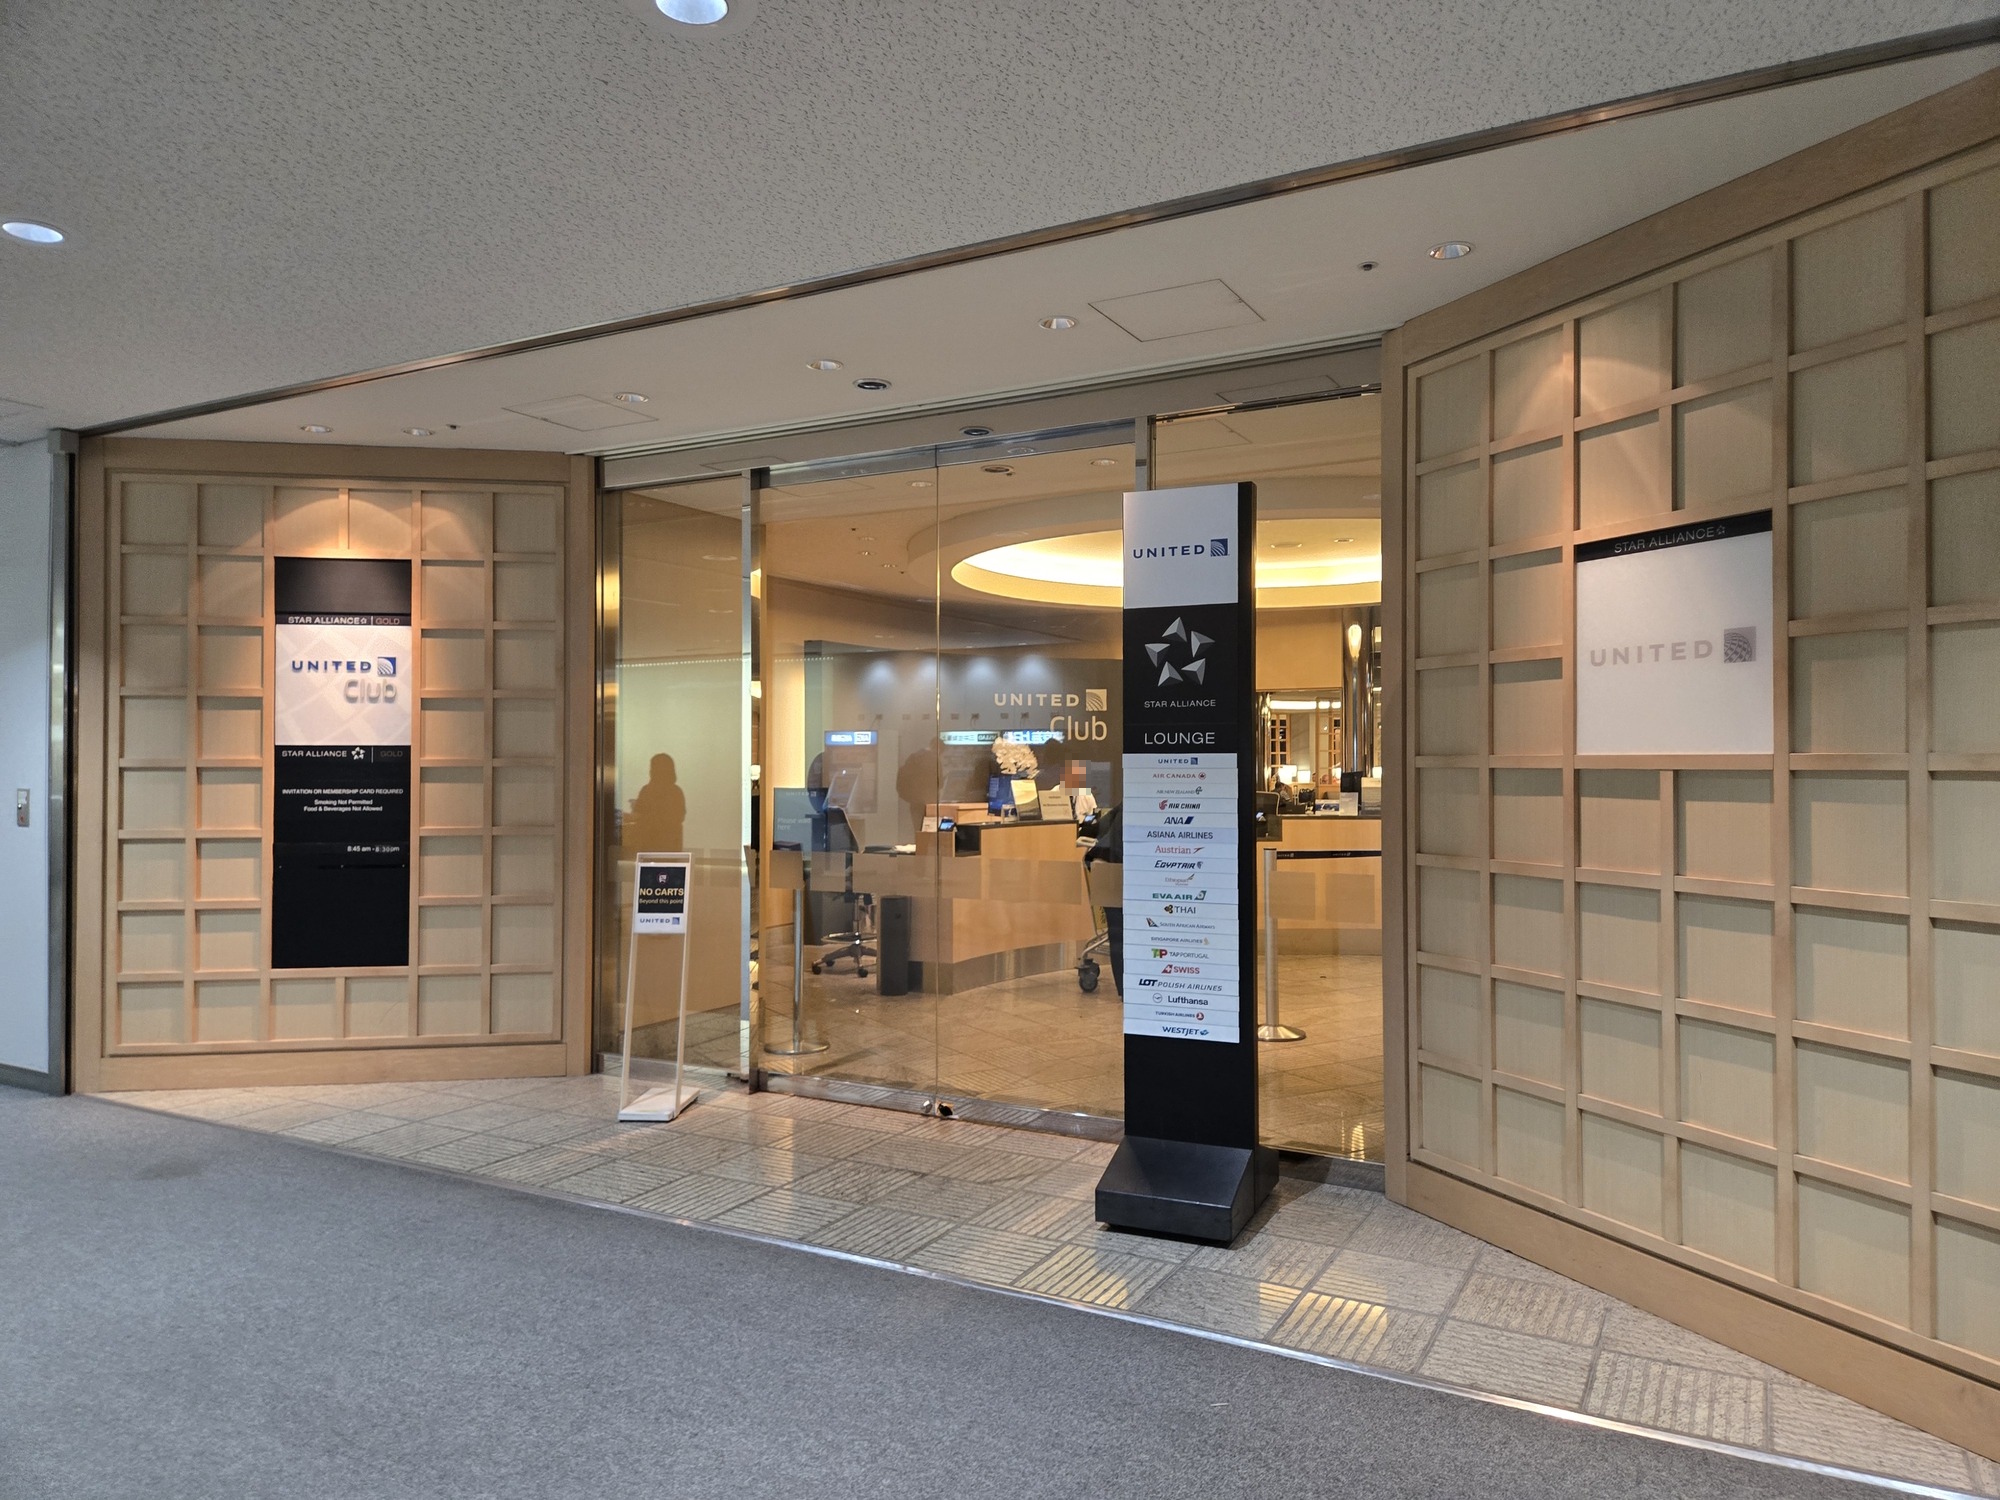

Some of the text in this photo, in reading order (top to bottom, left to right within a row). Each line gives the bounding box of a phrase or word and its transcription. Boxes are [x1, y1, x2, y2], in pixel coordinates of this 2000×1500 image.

[1614, 527, 1715, 553] STAR ALLIANCE
[1133, 545, 1205, 559] UNITED
[287, 616, 312, 624] STAR
[314, 617, 360, 625] ALLIANCE
[1590, 640, 1713, 667] UNITED
[292, 660, 372, 673] UNITED
[344, 679, 398, 704] Club
[994, 692, 1080, 707] UNITED
[1144, 699, 1216, 708] STAR ALLIANCE
[1049, 715, 1108, 742] Club
[1144, 732, 1215, 745] LOUNGE
[281, 750, 304, 758] STAR
[305, 750, 347, 758] ALLIANCE
[1164, 816, 1184, 825] ANA
[1177, 832, 1214, 840] AIRLINES
[1155, 845, 1191, 855] Austrian
[1154, 860, 1196, 870] EGYPTAIR
[640, 888, 684, 896] NO CARTS
[1152, 892, 1173, 900] EVA
[1174, 905, 1196, 914] THAI
[1151, 948, 1167, 959] TAP
[1180, 951, 1210, 959] PORTUGAL
[1173, 966, 1200, 974] SWISS
[1139, 978, 1223, 992] LOT POLISH AIRLINES
[1167, 995, 1209, 1006] Lufthansa
[1162, 1026, 1200, 1036] WESTJET
